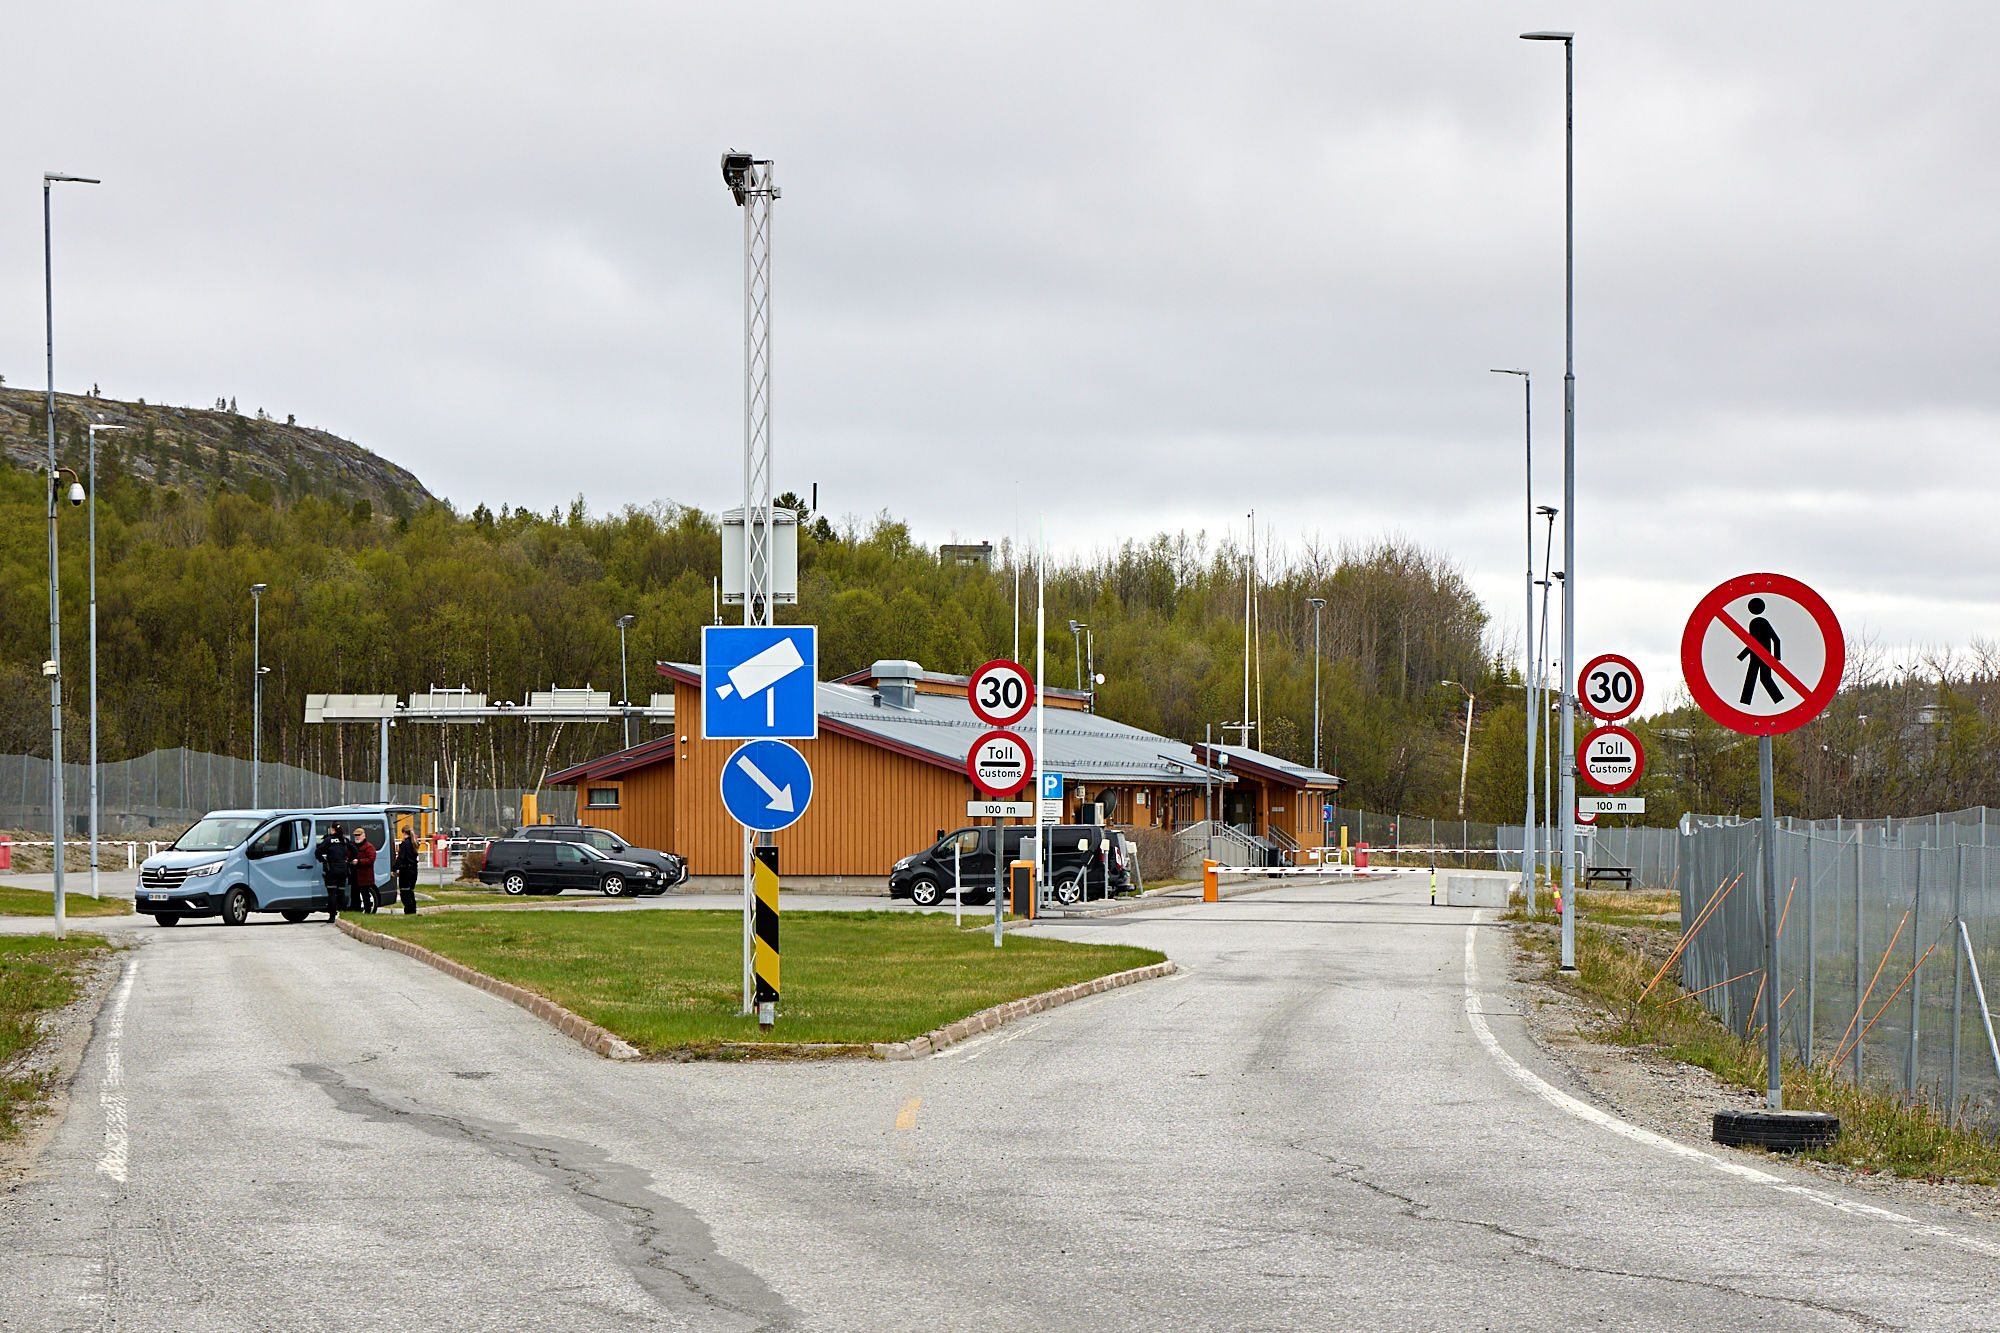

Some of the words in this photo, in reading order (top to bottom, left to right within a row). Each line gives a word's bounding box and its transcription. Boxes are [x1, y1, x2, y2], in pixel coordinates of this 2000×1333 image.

[980, 676, 1023, 709] 30
[1589, 671, 1633, 704] 30
[987, 746, 1013, 759] Toll
[1597, 741, 1623, 755] Toll
[978, 768, 1022, 778] Customs
[1589, 764, 1633, 774] Customs
[1045, 776, 1058, 796] P
[985, 805, 1001, 814] 100
[1006, 806, 1016, 814] m
[1596, 801, 1613, 811] 100
[1617, 802, 1627, 811] m
